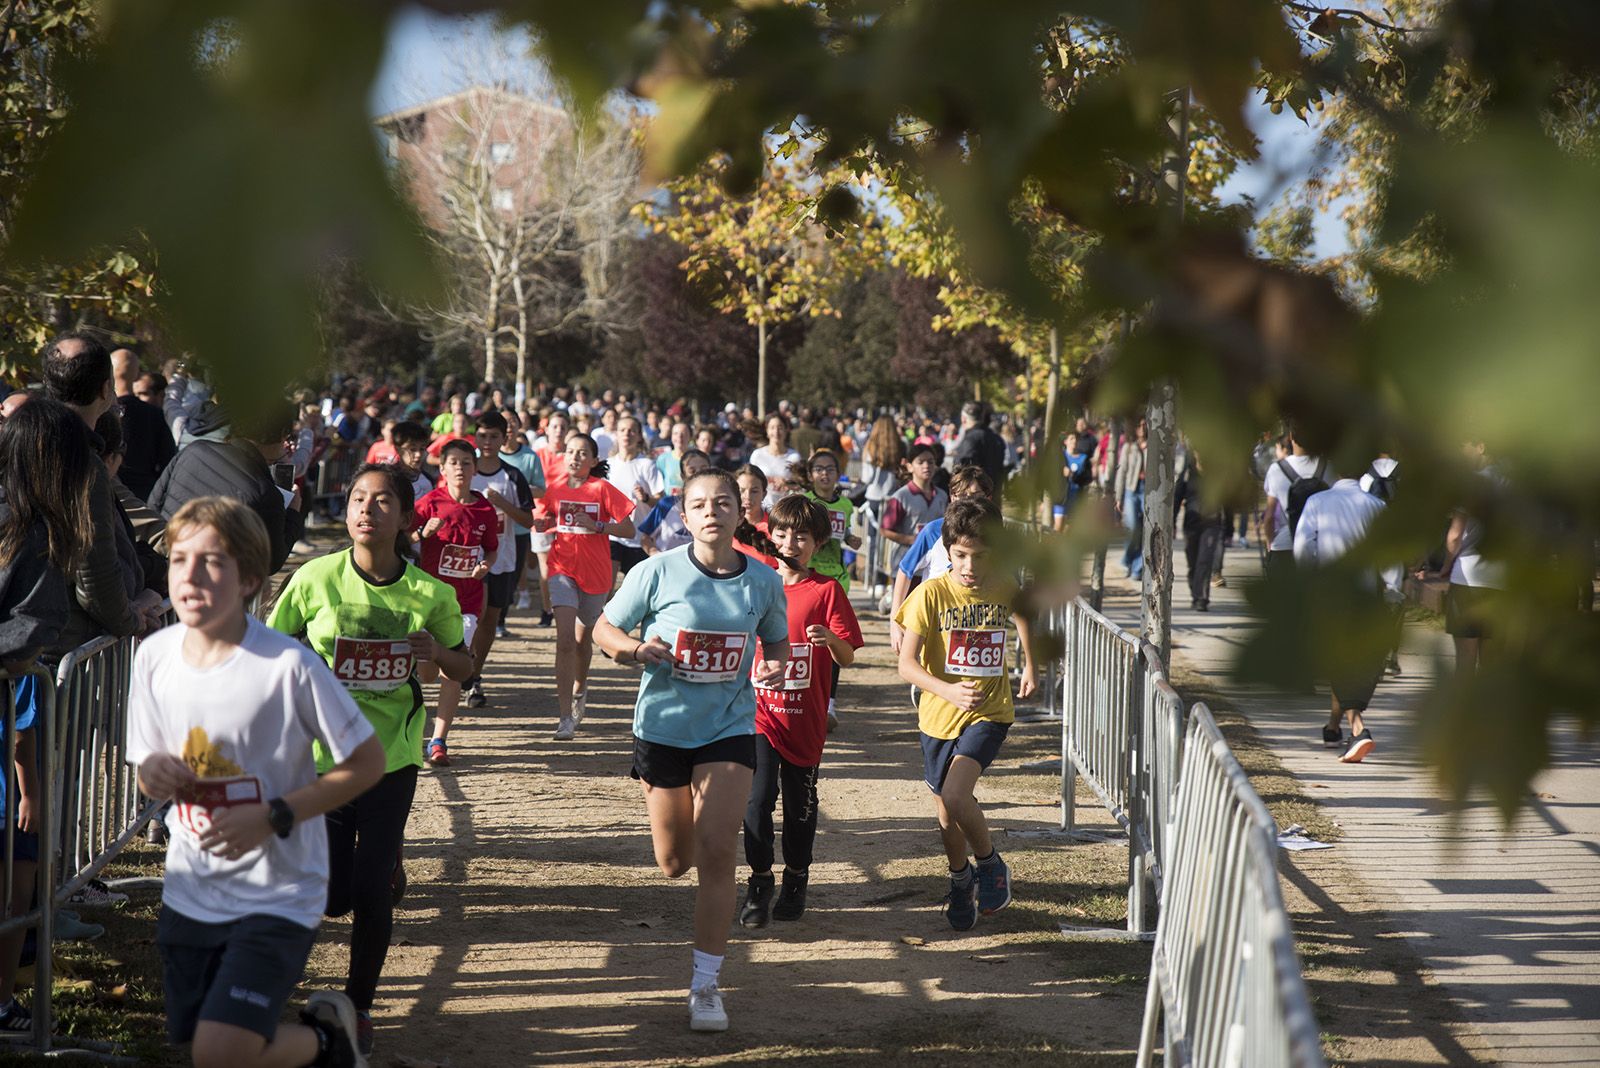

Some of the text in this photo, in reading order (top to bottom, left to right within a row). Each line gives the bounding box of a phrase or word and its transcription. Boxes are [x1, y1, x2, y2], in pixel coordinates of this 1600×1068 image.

[831, 520, 843, 532] 01
[442, 555, 476, 570] 2713
[937, 608, 959, 632] LOS
[679, 649, 739, 672] 1310
[952, 646, 1001, 666] 4669
[338, 657, 408, 680] 4588
[784, 660, 808, 679] 79
[180, 803, 221, 836] 16
